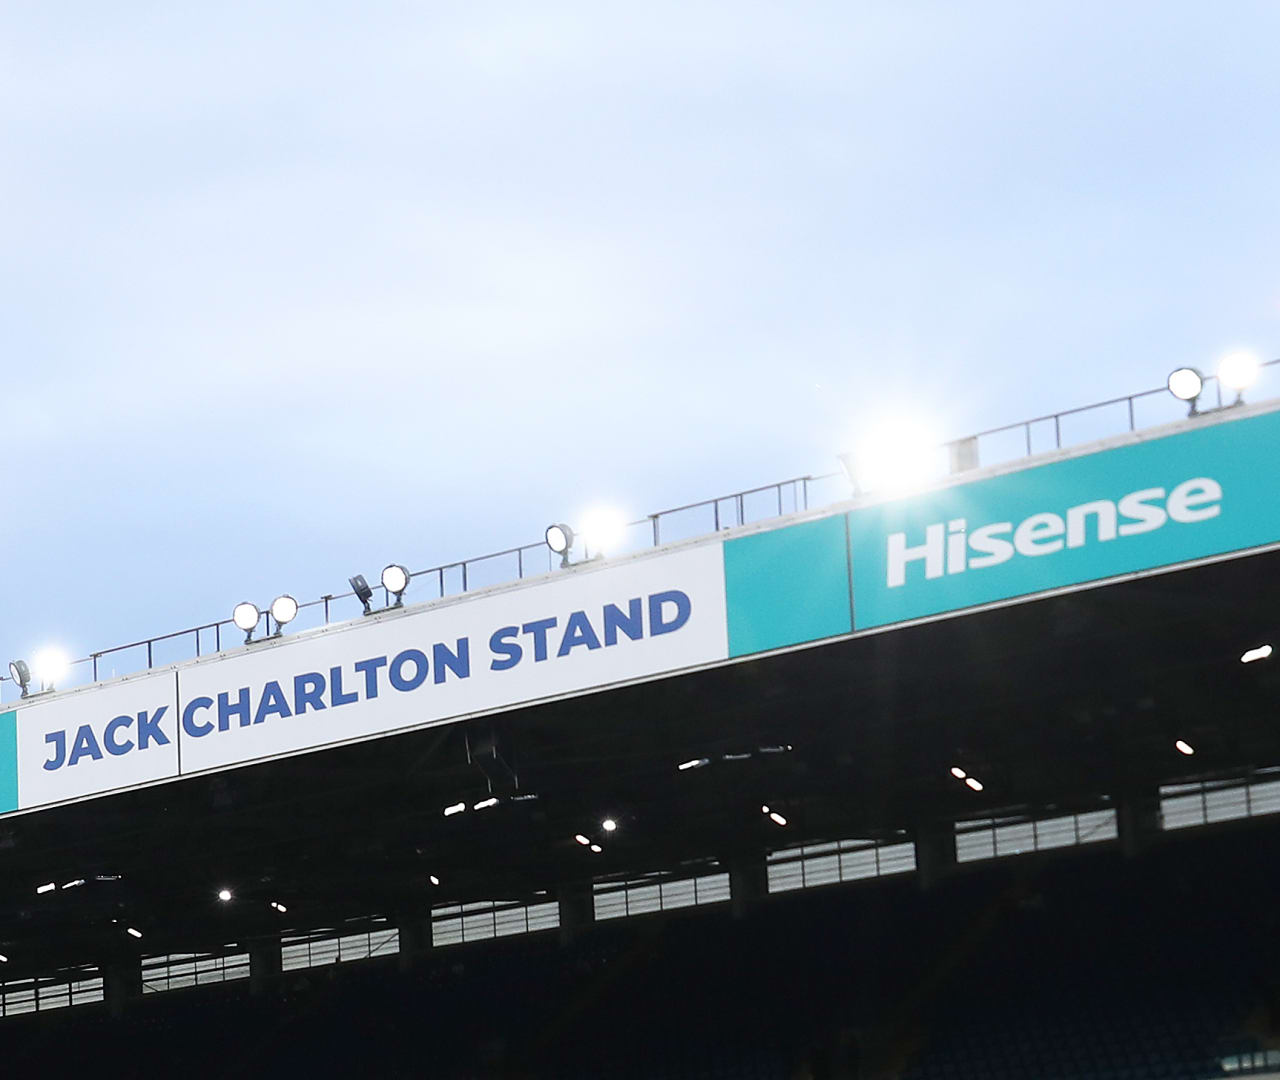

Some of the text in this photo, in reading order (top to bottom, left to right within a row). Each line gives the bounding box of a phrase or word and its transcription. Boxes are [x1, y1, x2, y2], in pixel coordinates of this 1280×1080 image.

[887, 477, 1221, 587] Hisense
[43, 590, 691, 771] JACK CHARLTON STAND
